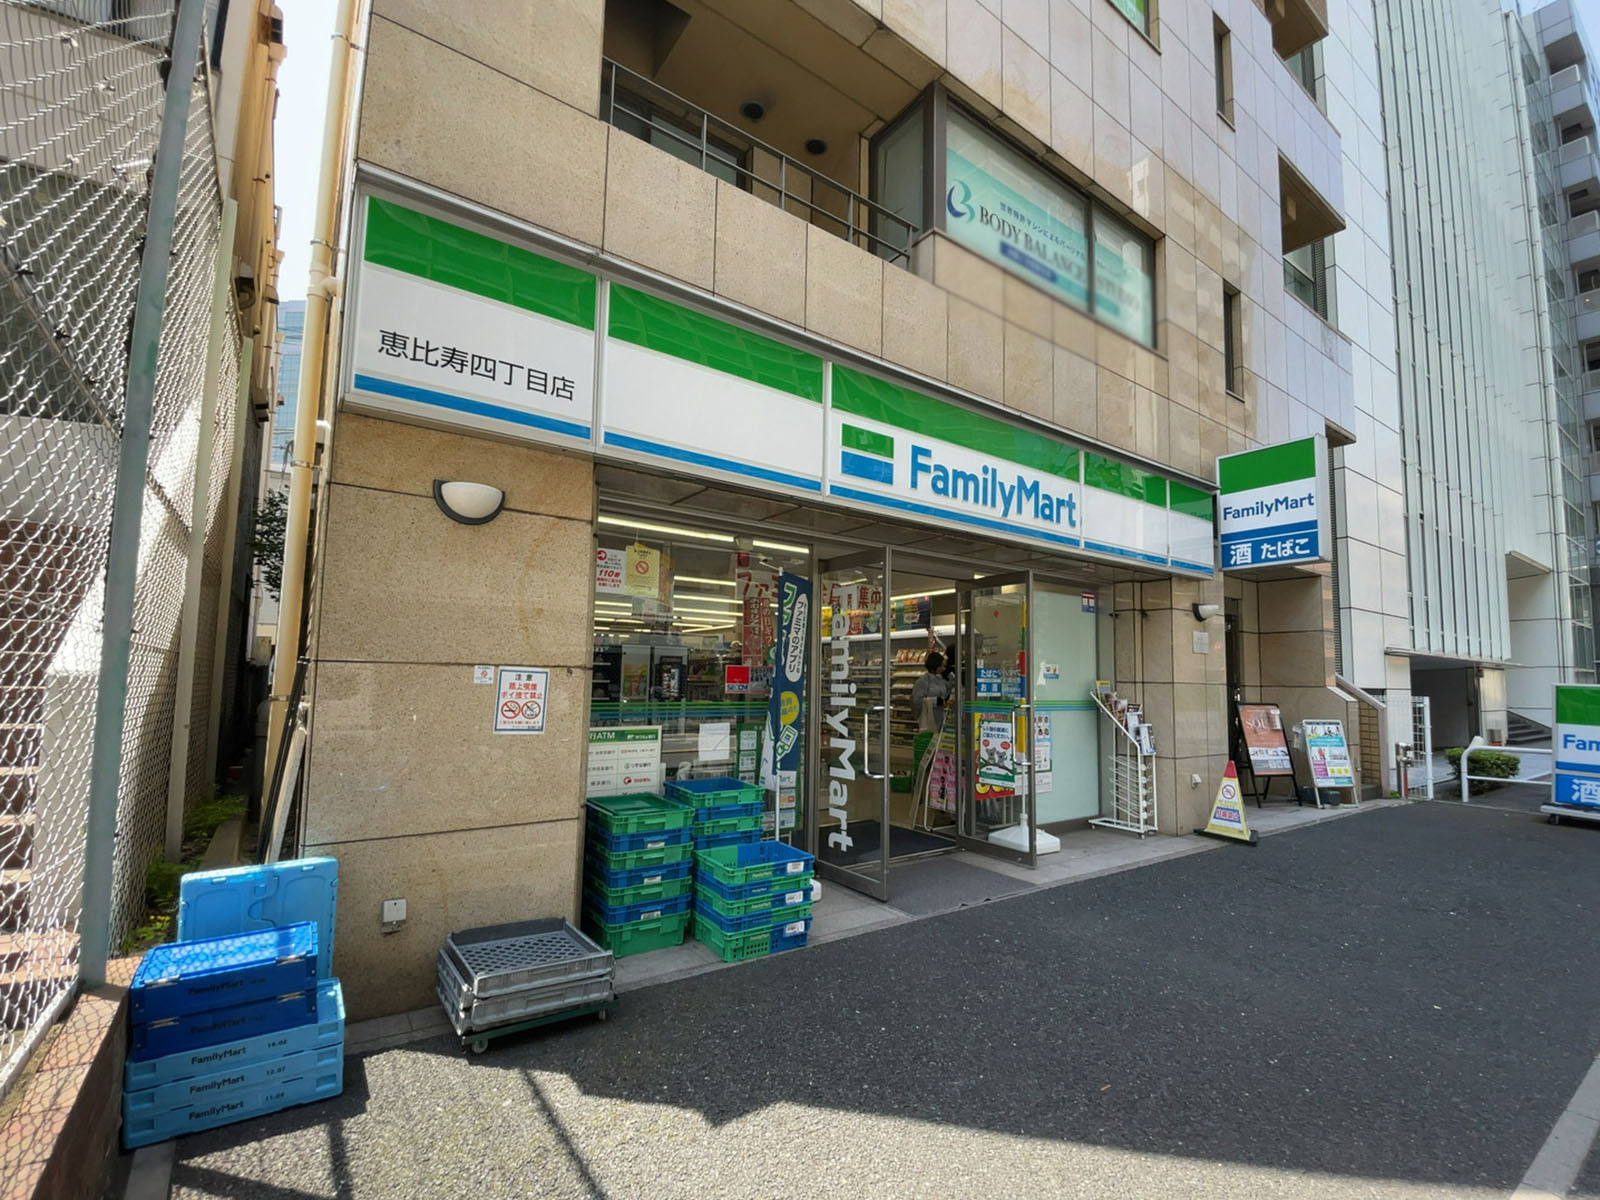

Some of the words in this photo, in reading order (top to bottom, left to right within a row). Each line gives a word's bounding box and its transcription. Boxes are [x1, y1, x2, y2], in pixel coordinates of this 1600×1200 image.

[980, 205, 1021, 243] BODY
[378, 329, 575, 401] 恵比寿四丁目店
[911, 445, 1076, 528] FamilyMart
[1223, 493, 1314, 520] FamilyMart
[1230, 542, 1252, 565] 酒
[1261, 538, 1310, 559] たばこ
[826, 585, 858, 852] FamilyMart
[191, 1046, 246, 1064] FamilyMart
[189, 1074, 245, 1094] FamilyMart
[188, 1100, 244, 1120] FamilyMart
